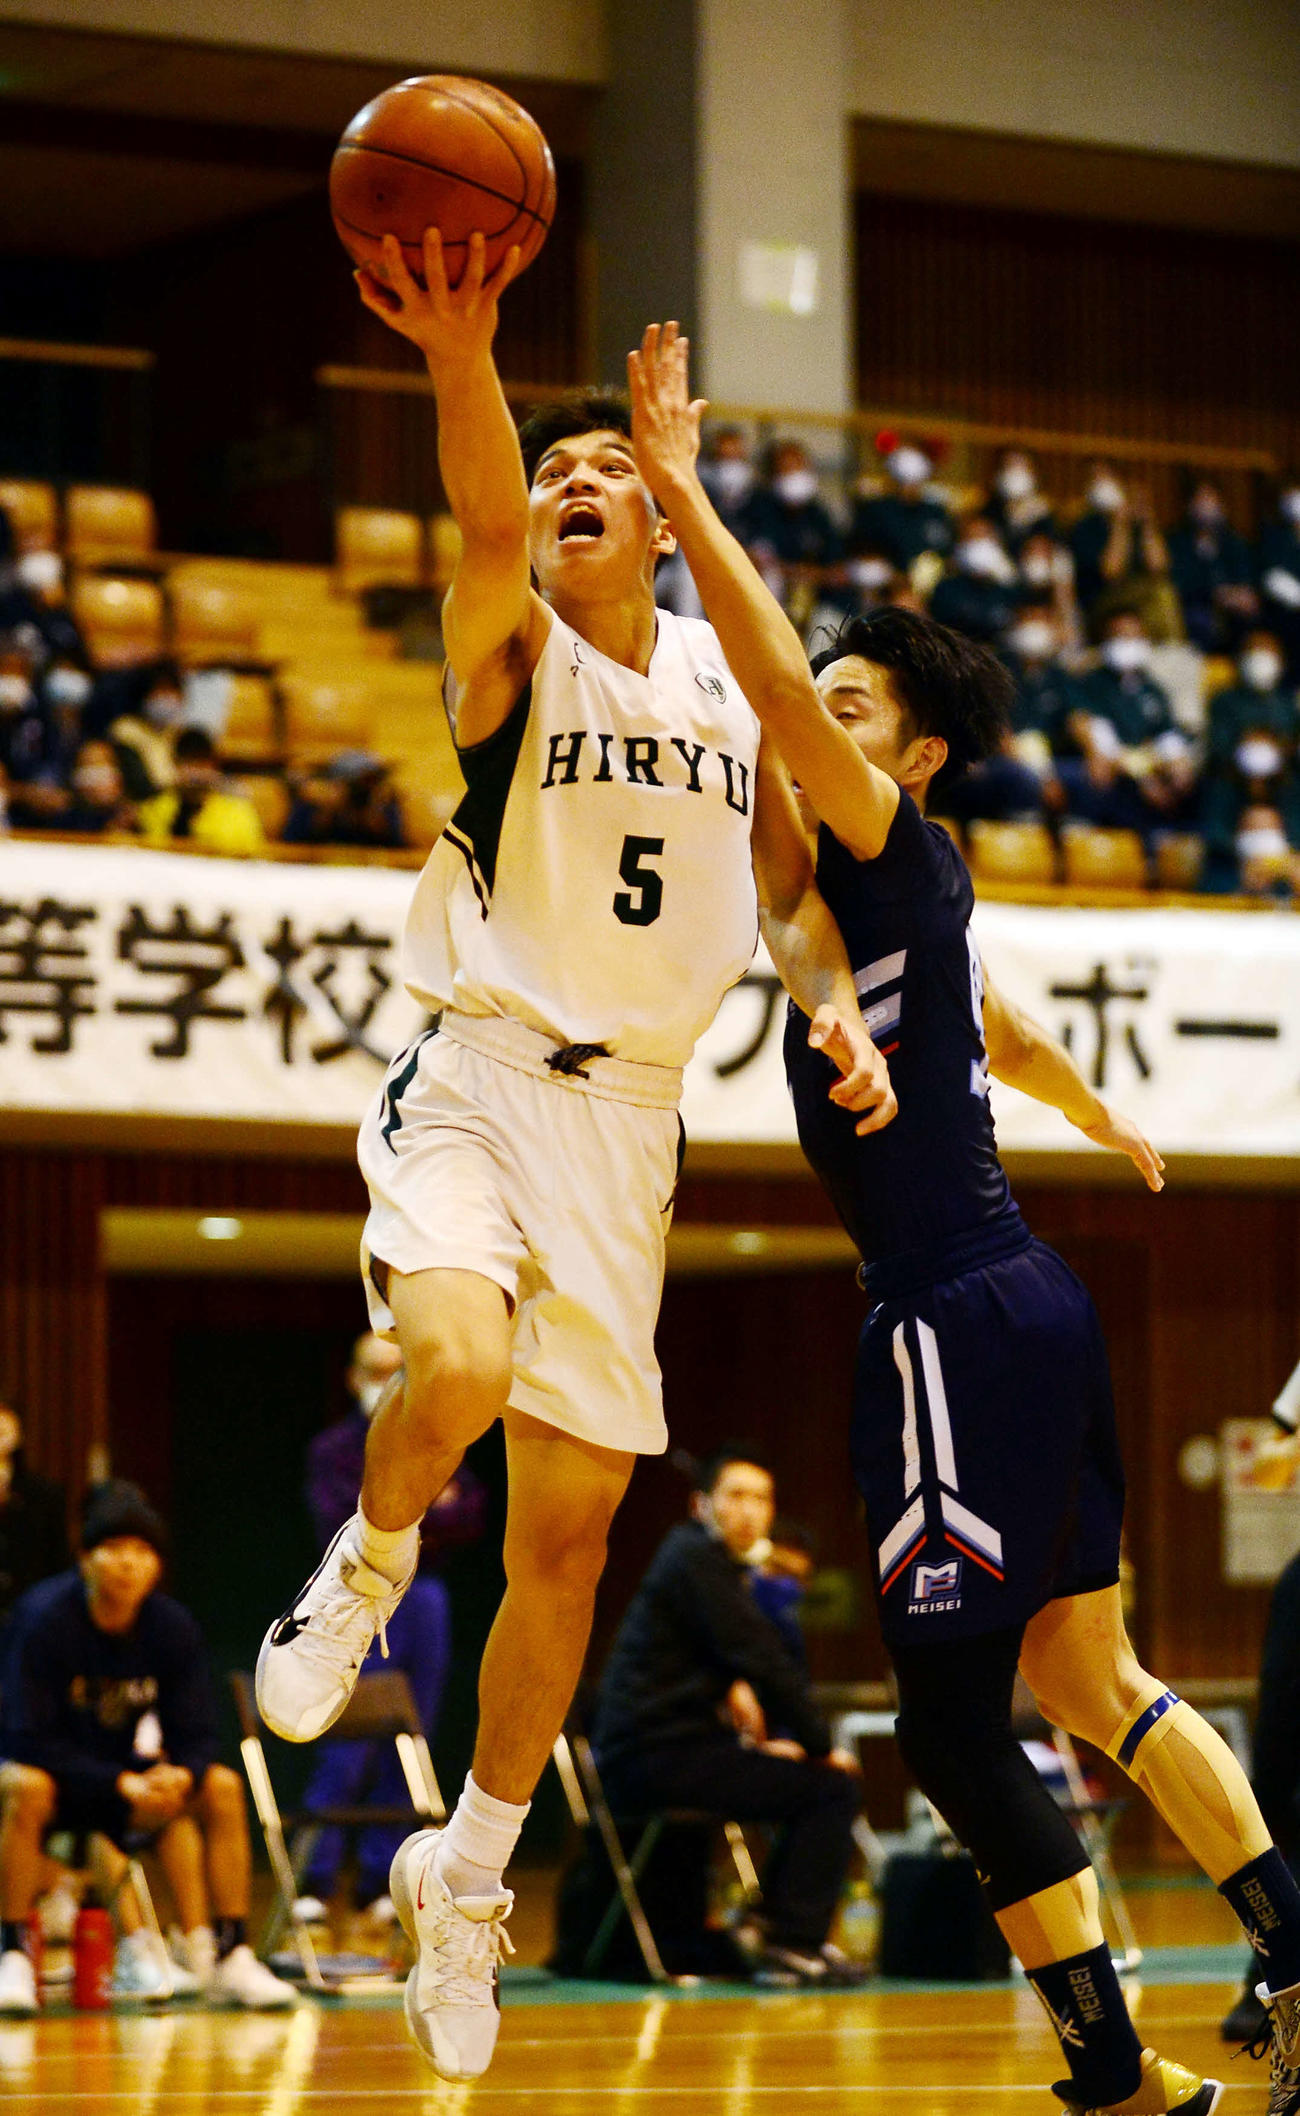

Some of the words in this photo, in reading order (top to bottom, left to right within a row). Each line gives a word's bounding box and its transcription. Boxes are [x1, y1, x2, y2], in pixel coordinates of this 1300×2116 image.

[540, 731, 749, 816] HIRYU
[612, 834, 665, 927] 5
[907, 1599, 961, 1615] MEISEI
[1240, 1876, 1281, 1932] MEISEI
[1066, 1965, 1106, 2024] MEISEI
